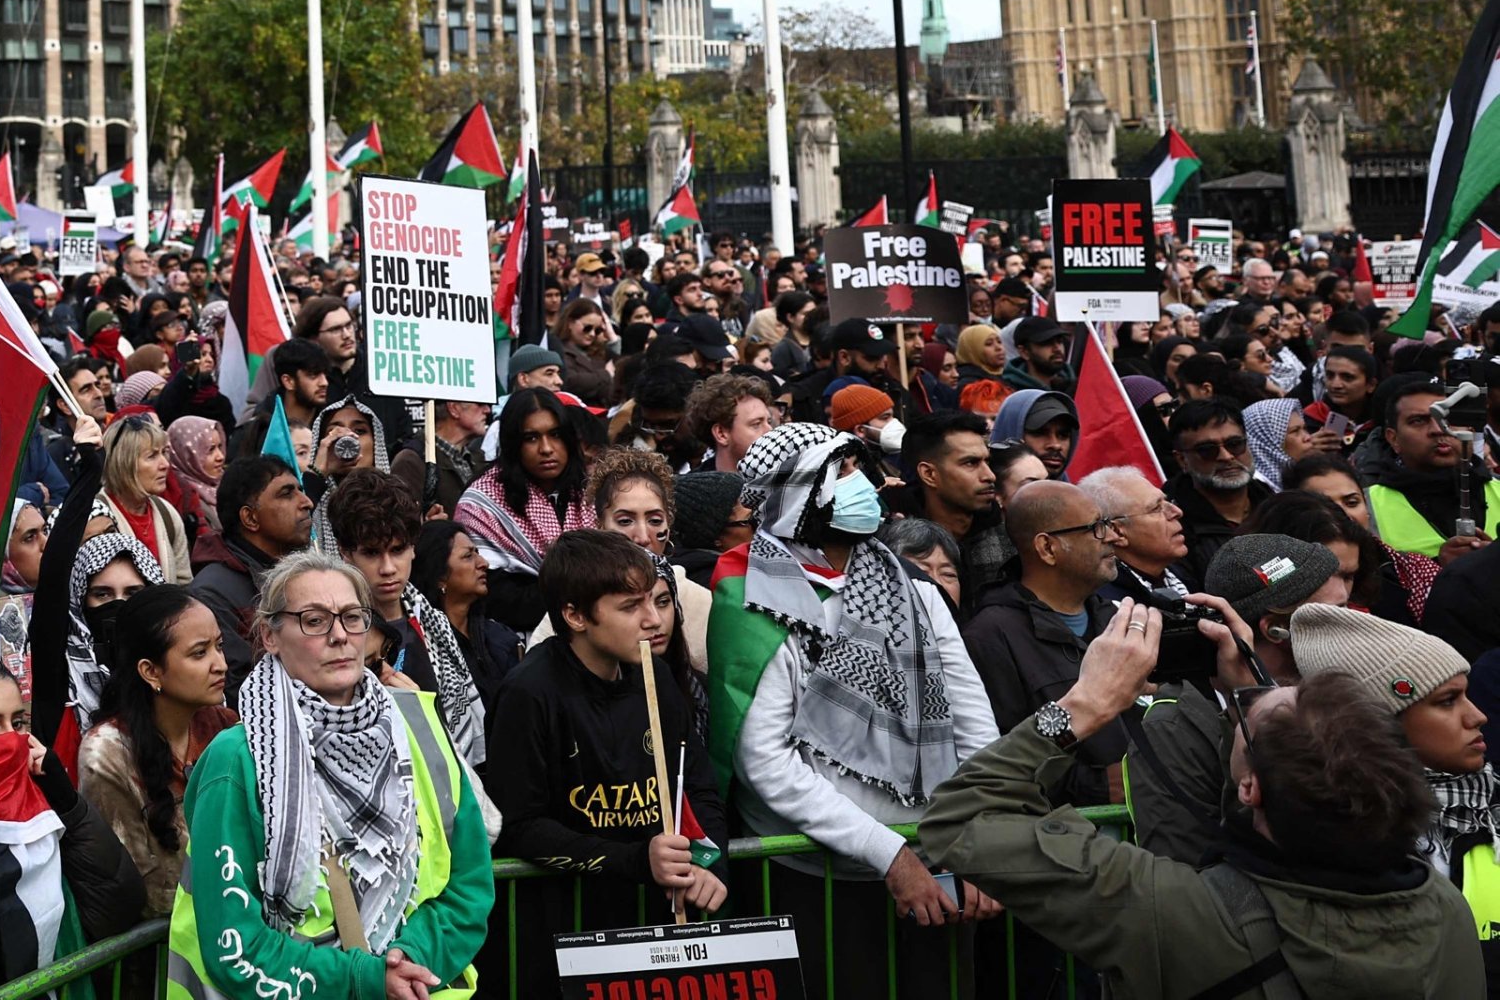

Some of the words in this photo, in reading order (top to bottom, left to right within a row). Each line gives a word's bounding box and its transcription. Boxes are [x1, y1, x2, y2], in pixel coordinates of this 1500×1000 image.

[368, 190, 417, 222] STOP
[1063, 203, 1143, 244] FREE
[63, 239, 95, 254] FREE
[370, 221, 463, 257] GENOCIDE
[863, 231, 927, 258] Free
[1192, 242, 1229, 256] FREE
[1063, 247, 1146, 267] PALESTINE
[371, 255, 409, 286] END
[416, 259, 450, 289] THE
[831, 260, 961, 289] Palestine
[371, 286, 489, 324] OCCUPATION
[373, 319, 421, 351] FREE
[374, 351, 475, 388] PALESTINE
[588, 805, 660, 828] AIRWAYS
[651, 953, 680, 964] FRIENDS
[684, 943, 708, 961] FOA
